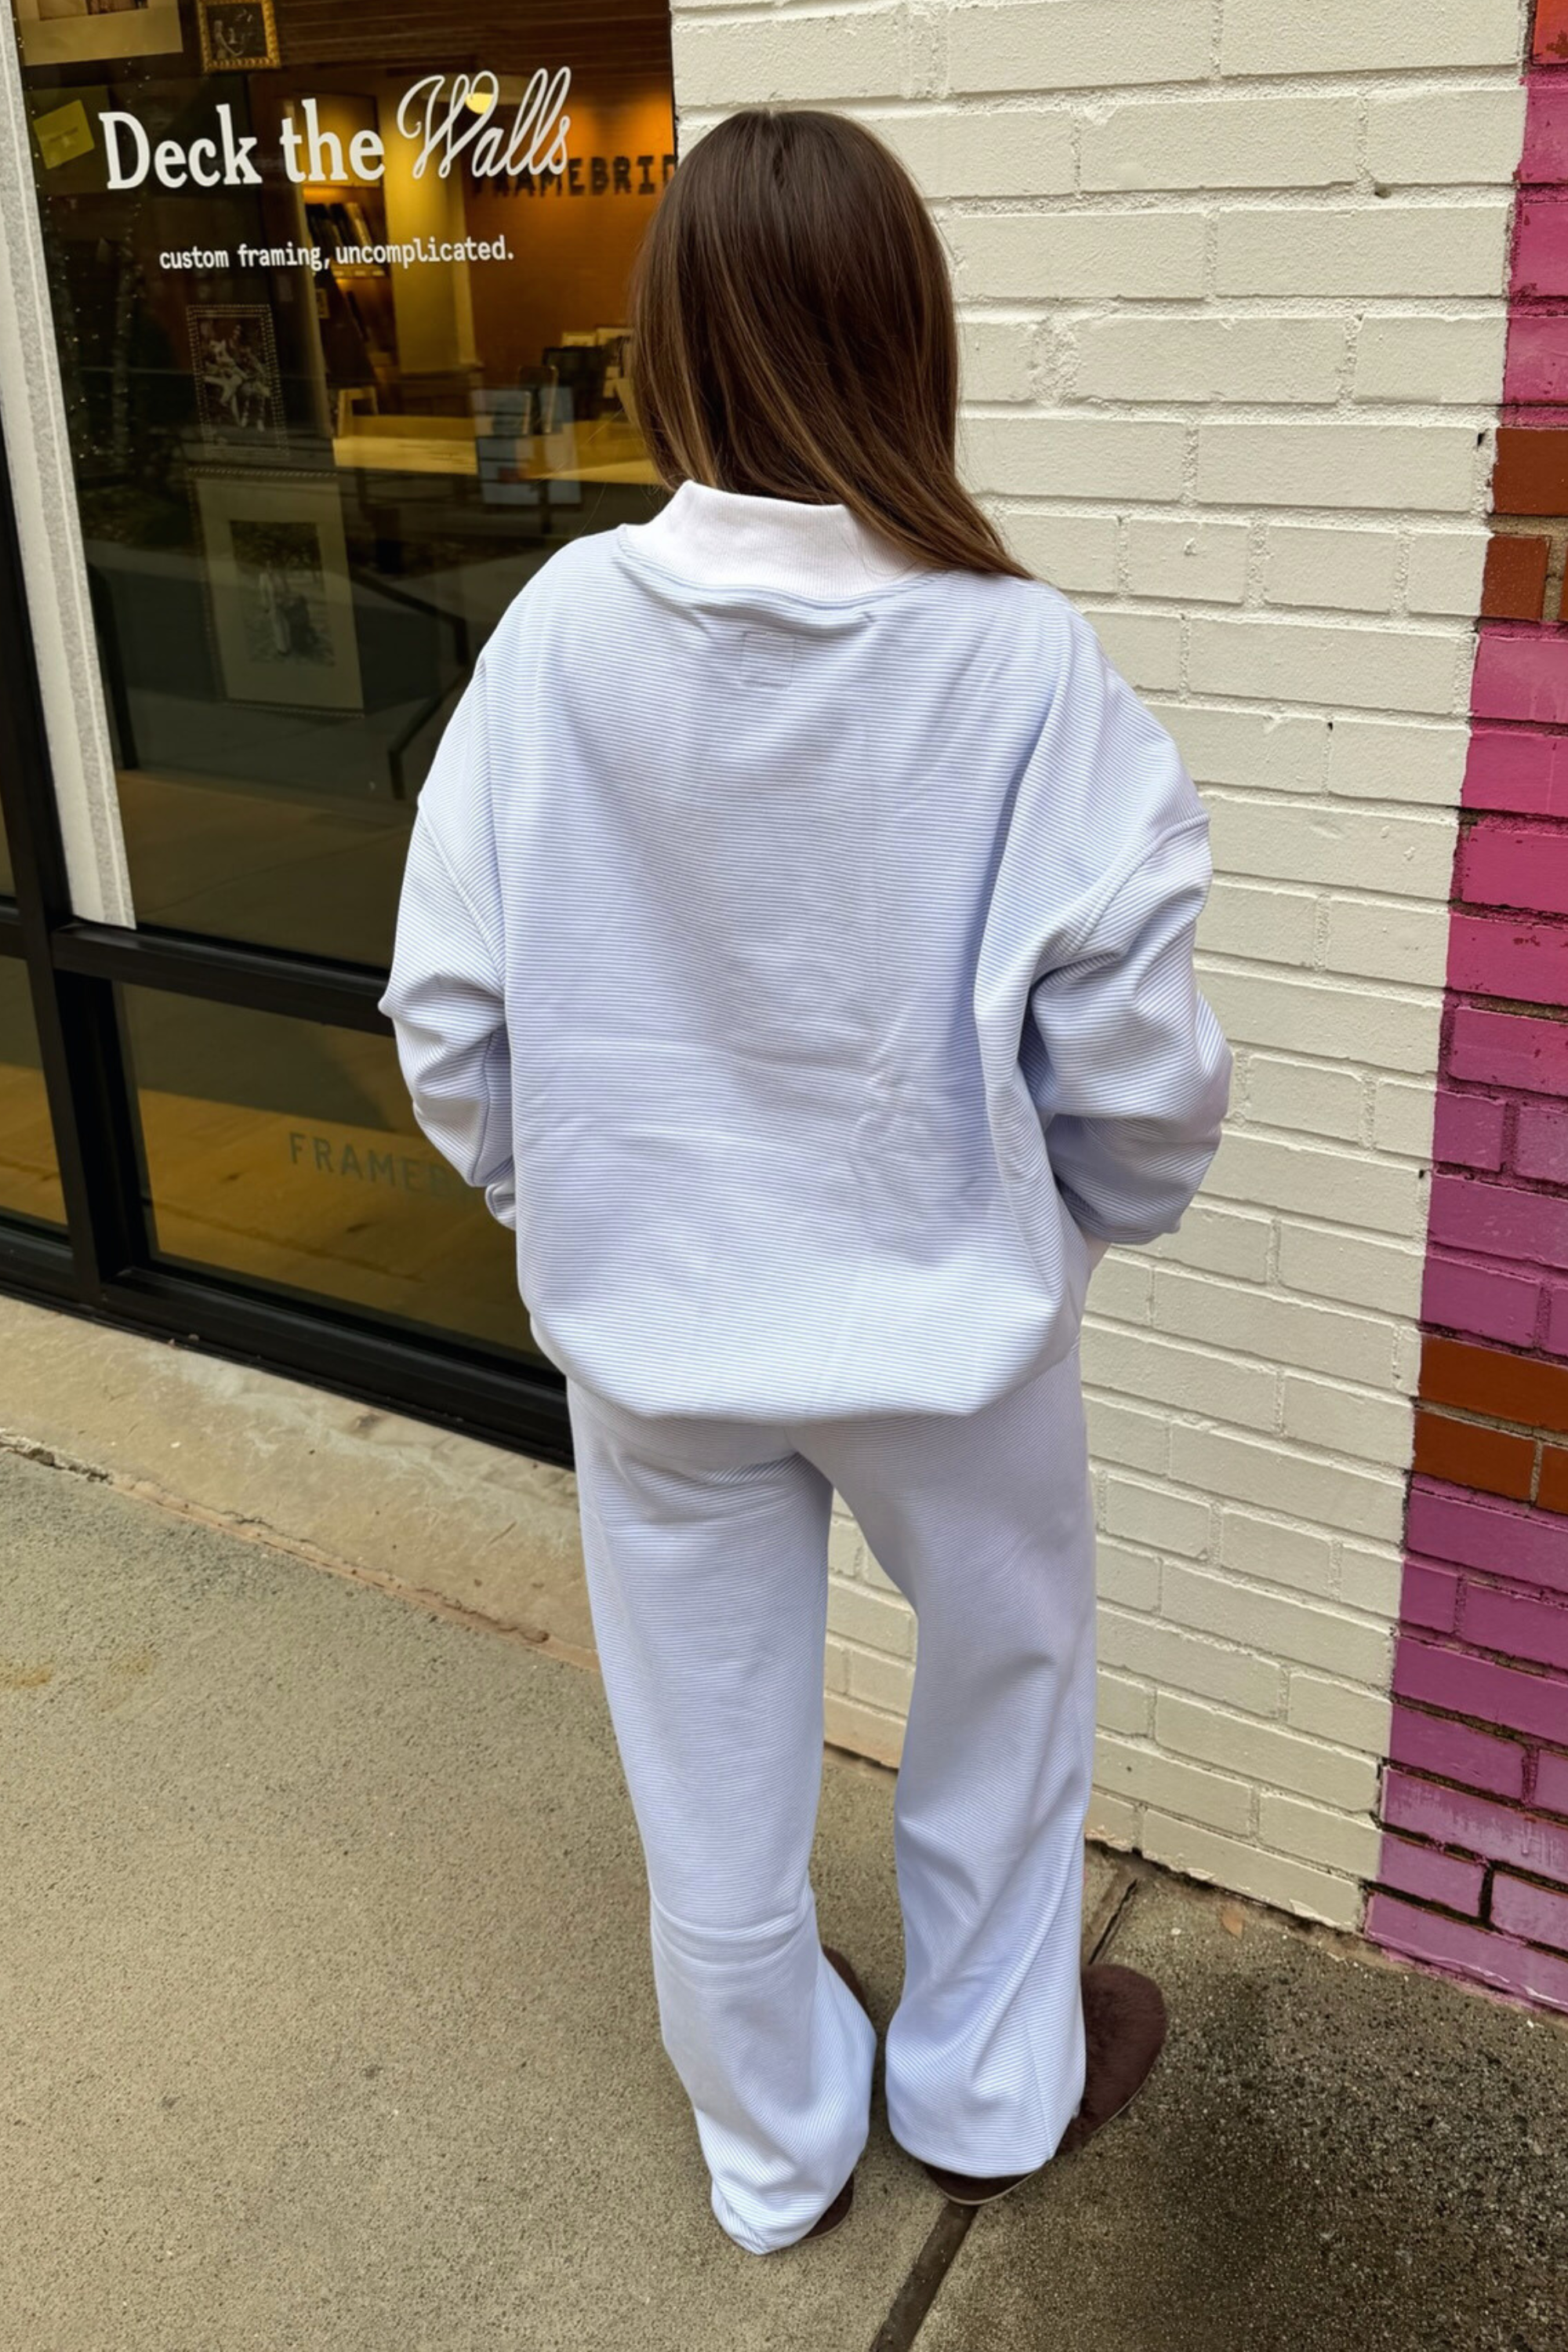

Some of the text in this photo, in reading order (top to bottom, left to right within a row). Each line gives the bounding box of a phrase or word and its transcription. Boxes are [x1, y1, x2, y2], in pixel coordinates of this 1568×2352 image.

[98, 66, 572, 189] Deck the Walls
[159, 234, 514, 271] custom framing, uncomplicated.
